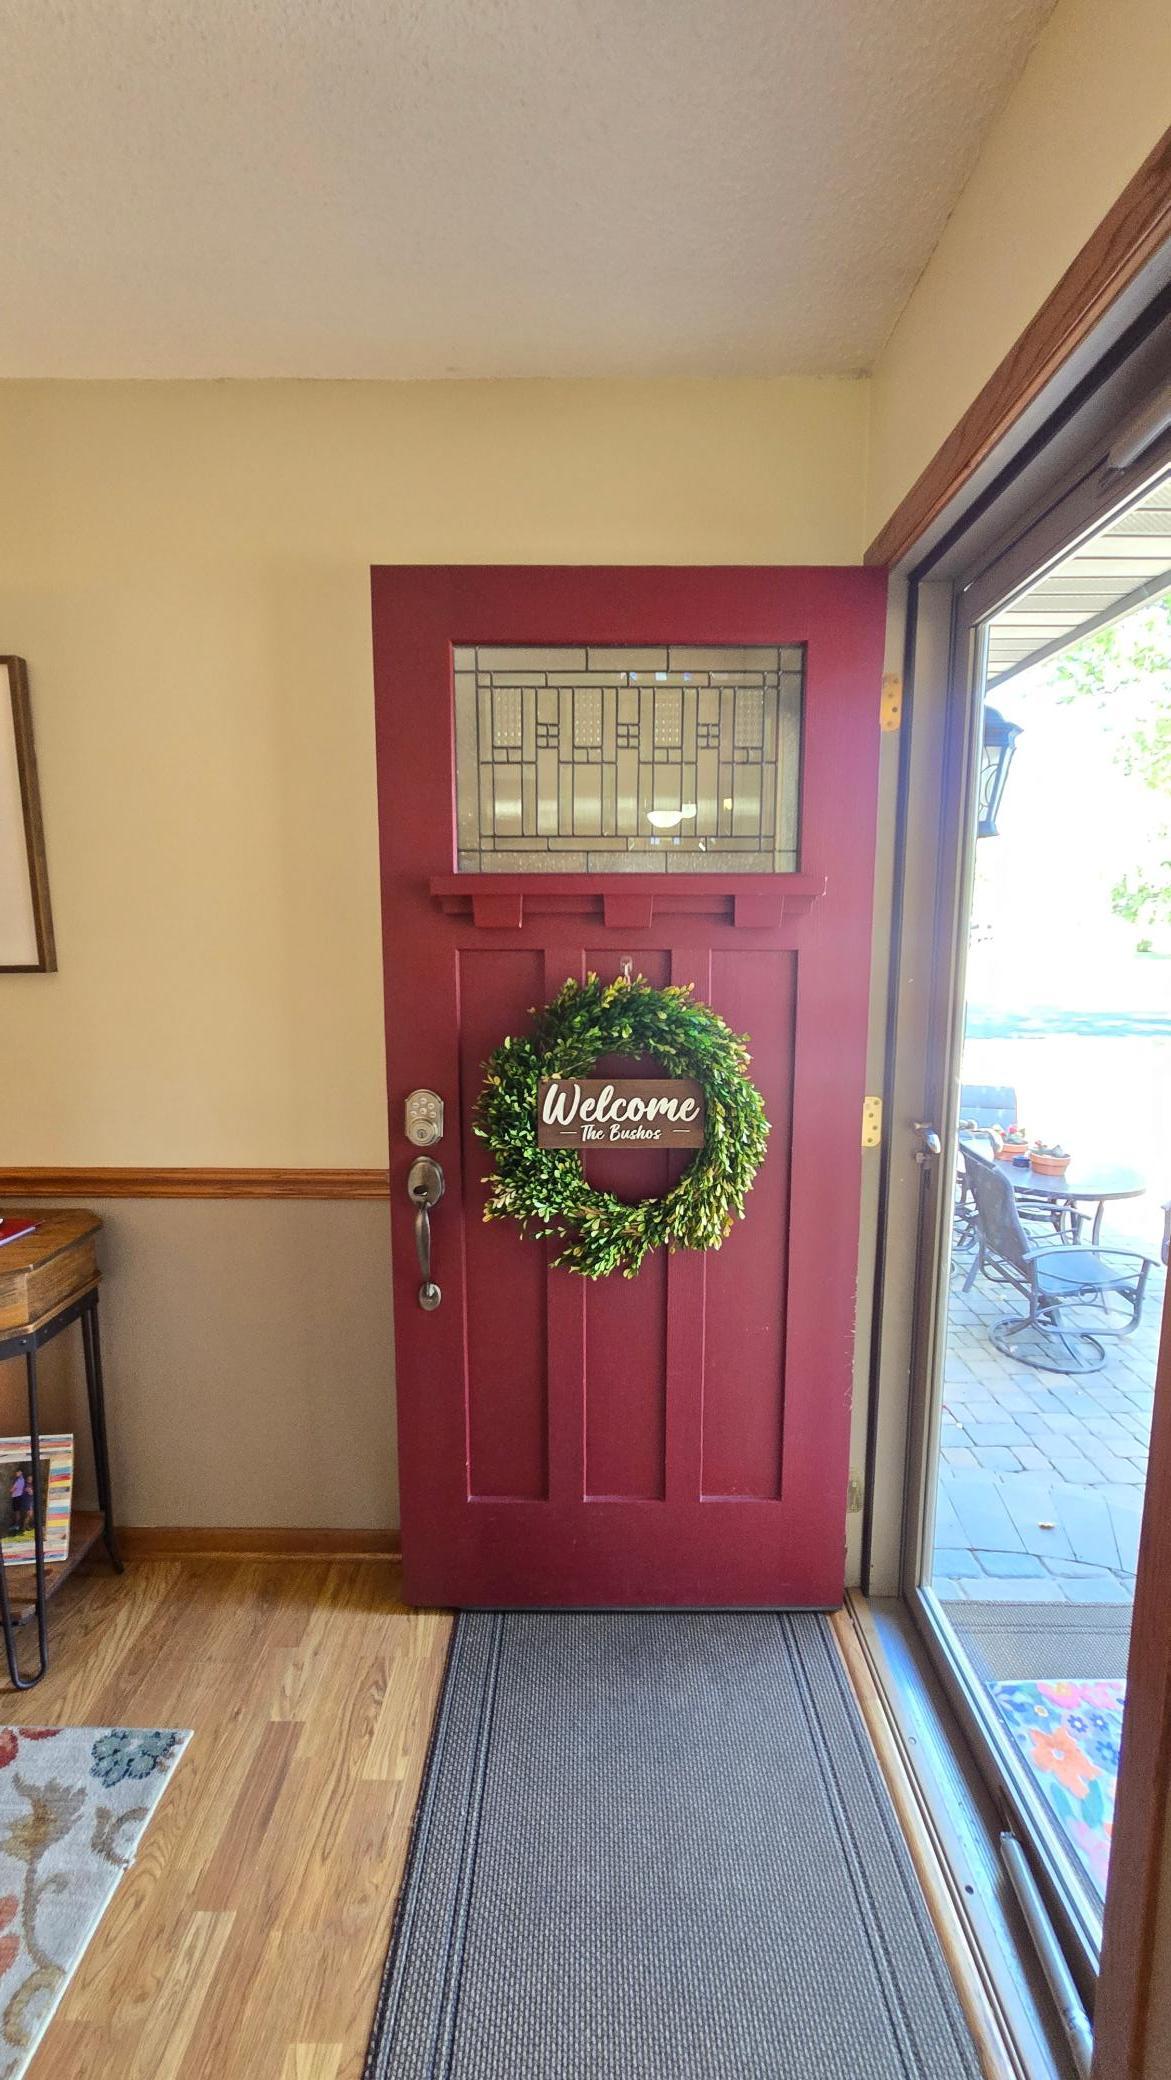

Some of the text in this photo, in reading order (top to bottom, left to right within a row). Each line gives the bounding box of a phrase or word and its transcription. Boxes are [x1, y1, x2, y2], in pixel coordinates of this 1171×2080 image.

[542, 1083, 700, 1126] Welcome
[580, 1123, 662, 1142] The Bushos
